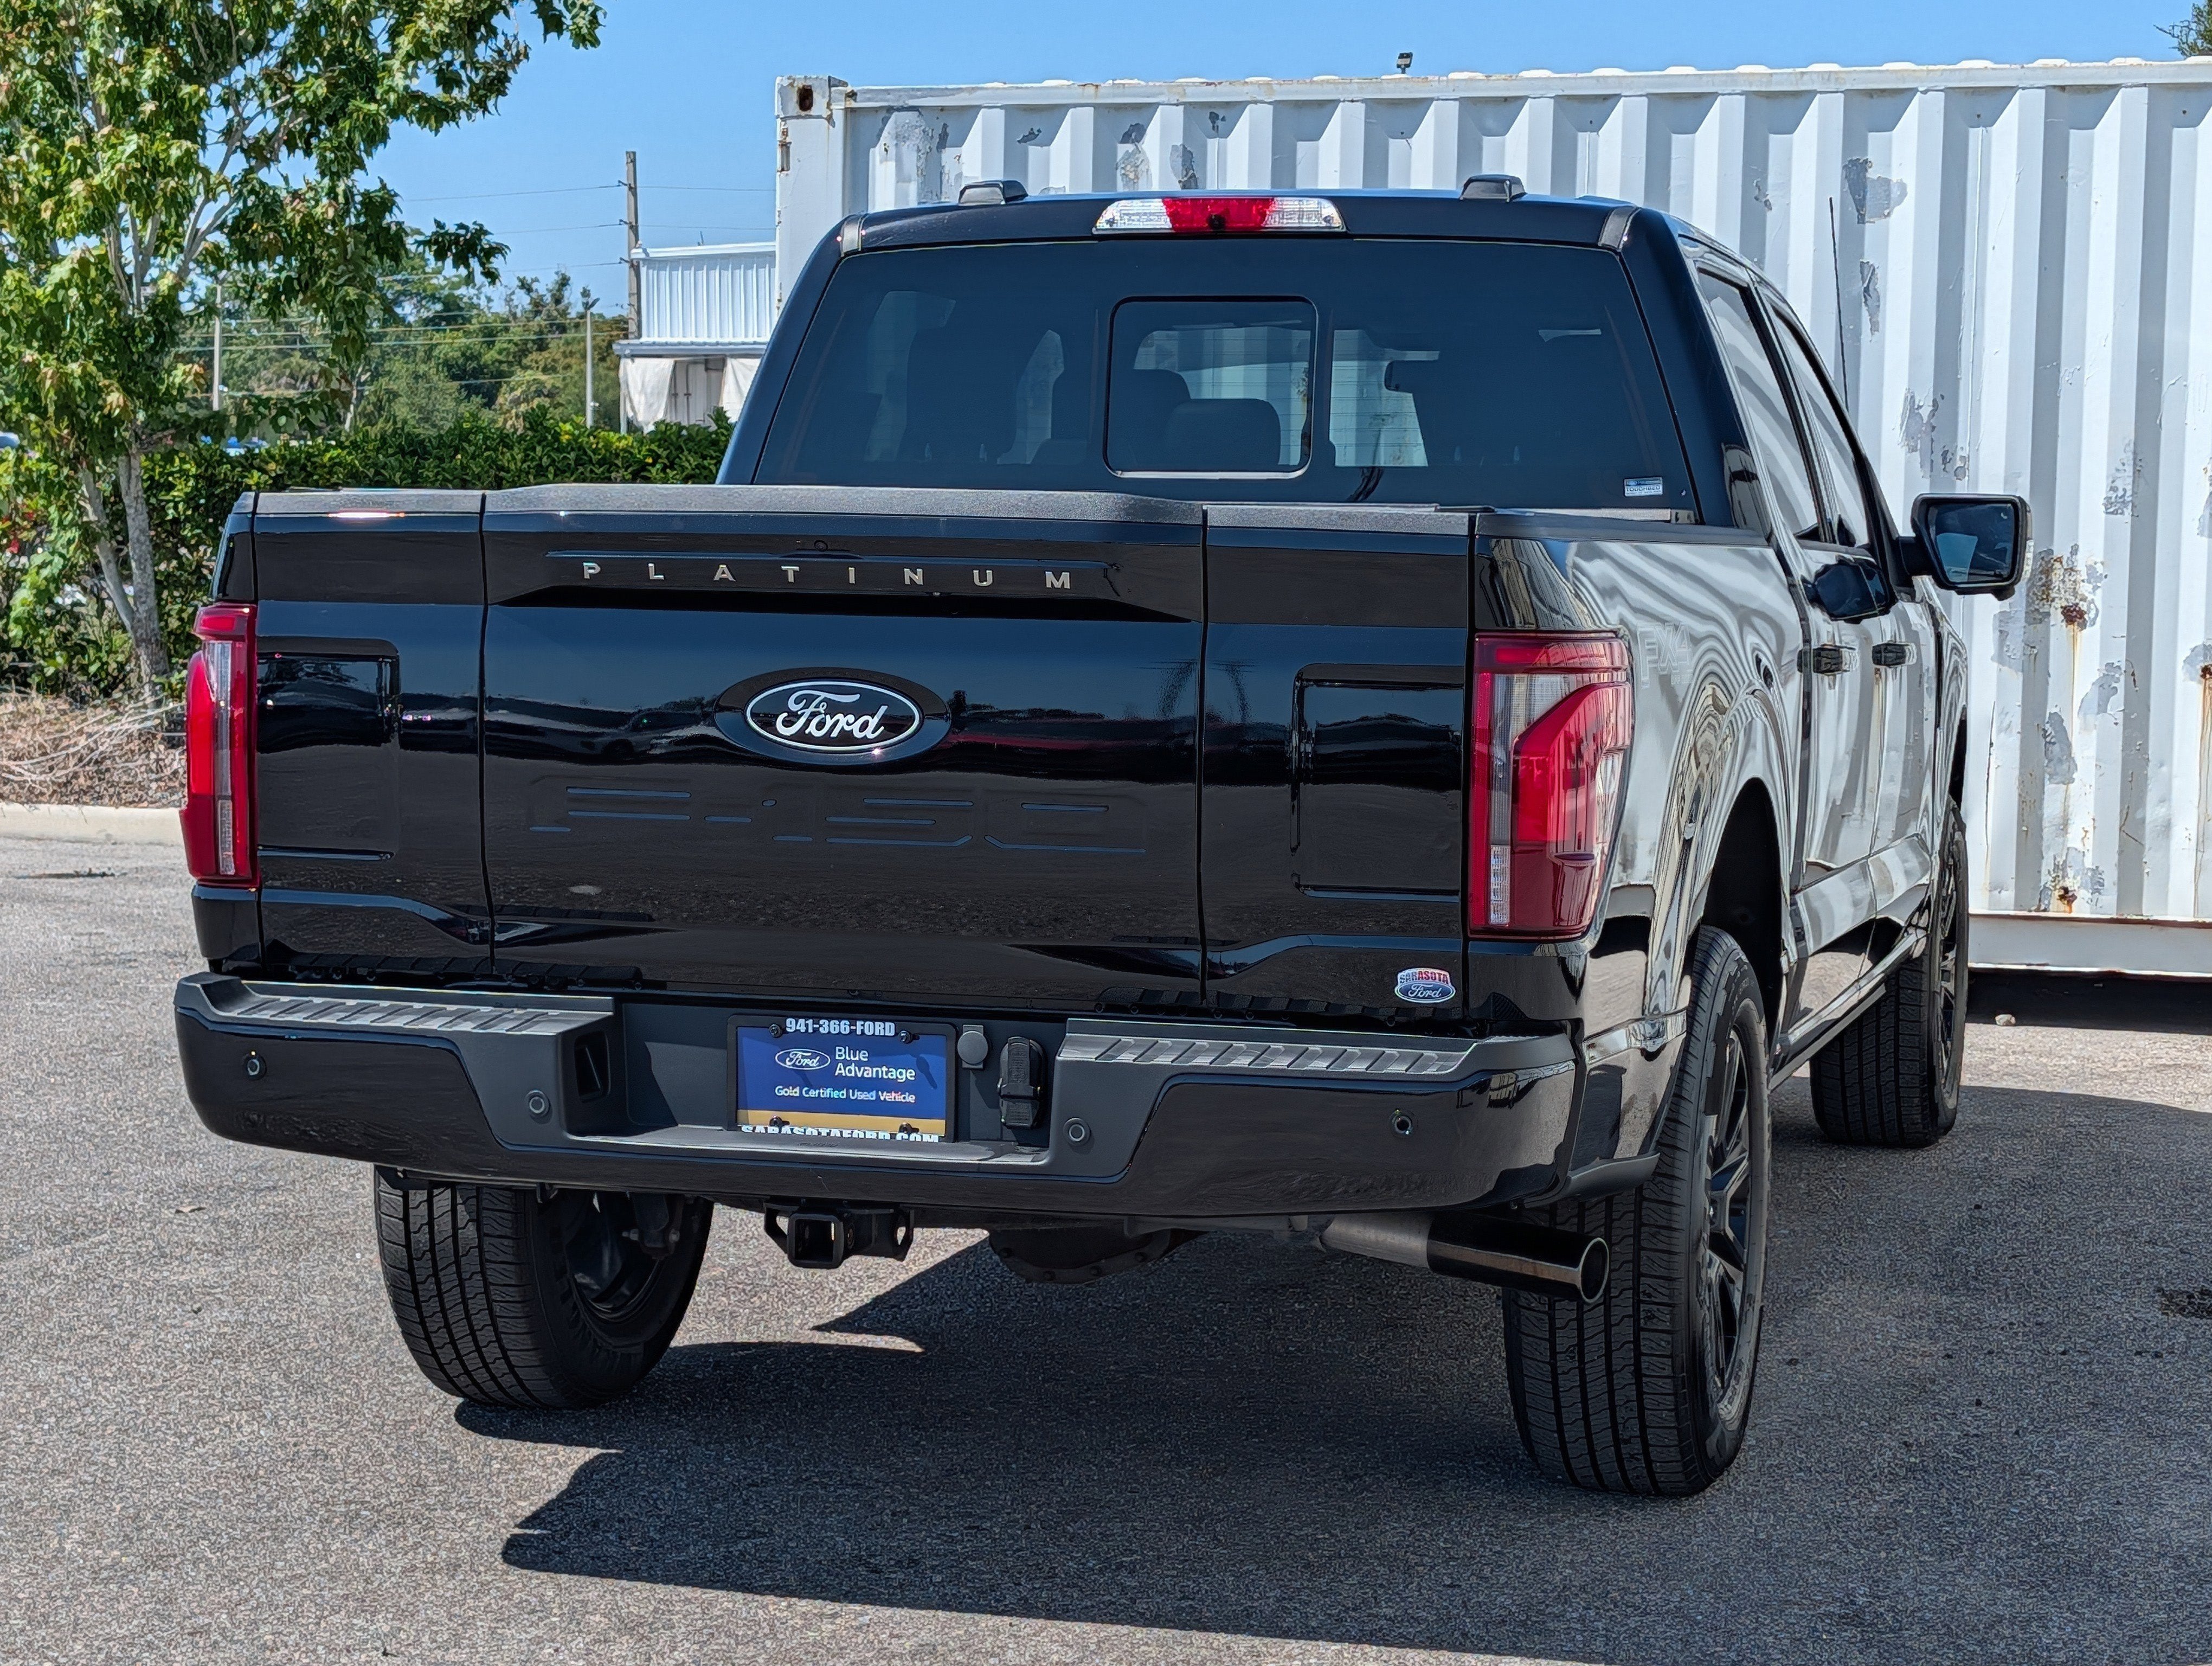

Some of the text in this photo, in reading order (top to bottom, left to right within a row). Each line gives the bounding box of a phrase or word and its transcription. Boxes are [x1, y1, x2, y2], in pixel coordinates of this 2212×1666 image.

[583, 562, 1071, 589] PLATINUM
[1637, 621, 1693, 689] FX4
[776, 690, 889, 739] Ford
[1400, 970, 1449, 984] SARASOTA
[1408, 983, 1442, 998] Ford
[786, 1018, 896, 1036] 941-366-FORD
[786, 1052, 820, 1067] Ford
[835, 1047, 869, 1062] Blue
[834, 1063, 916, 1082] Advantage
[775, 1085, 916, 1103] Gold Certified Used Vehicle
